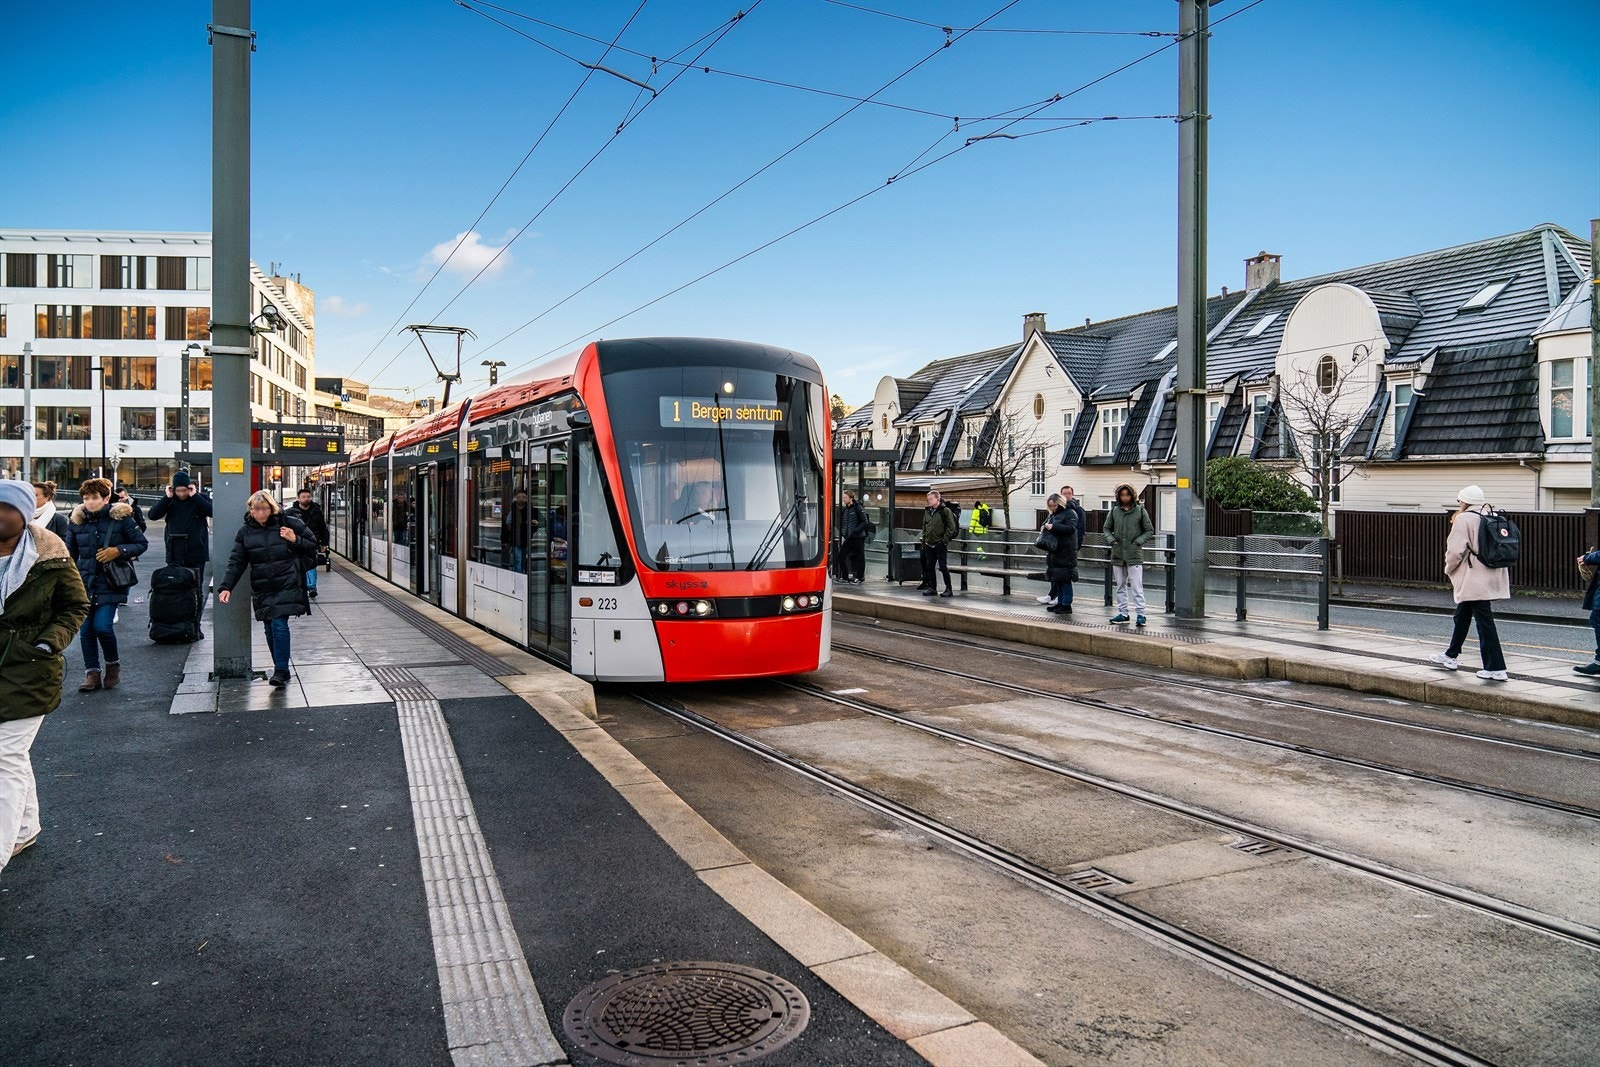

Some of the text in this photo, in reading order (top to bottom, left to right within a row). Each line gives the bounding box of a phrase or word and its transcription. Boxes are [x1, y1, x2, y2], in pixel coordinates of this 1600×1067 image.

[673, 401, 783, 423] 1 Bergen sentrum
[665, 580, 699, 590] skyss
[598, 598, 618, 610] 223
